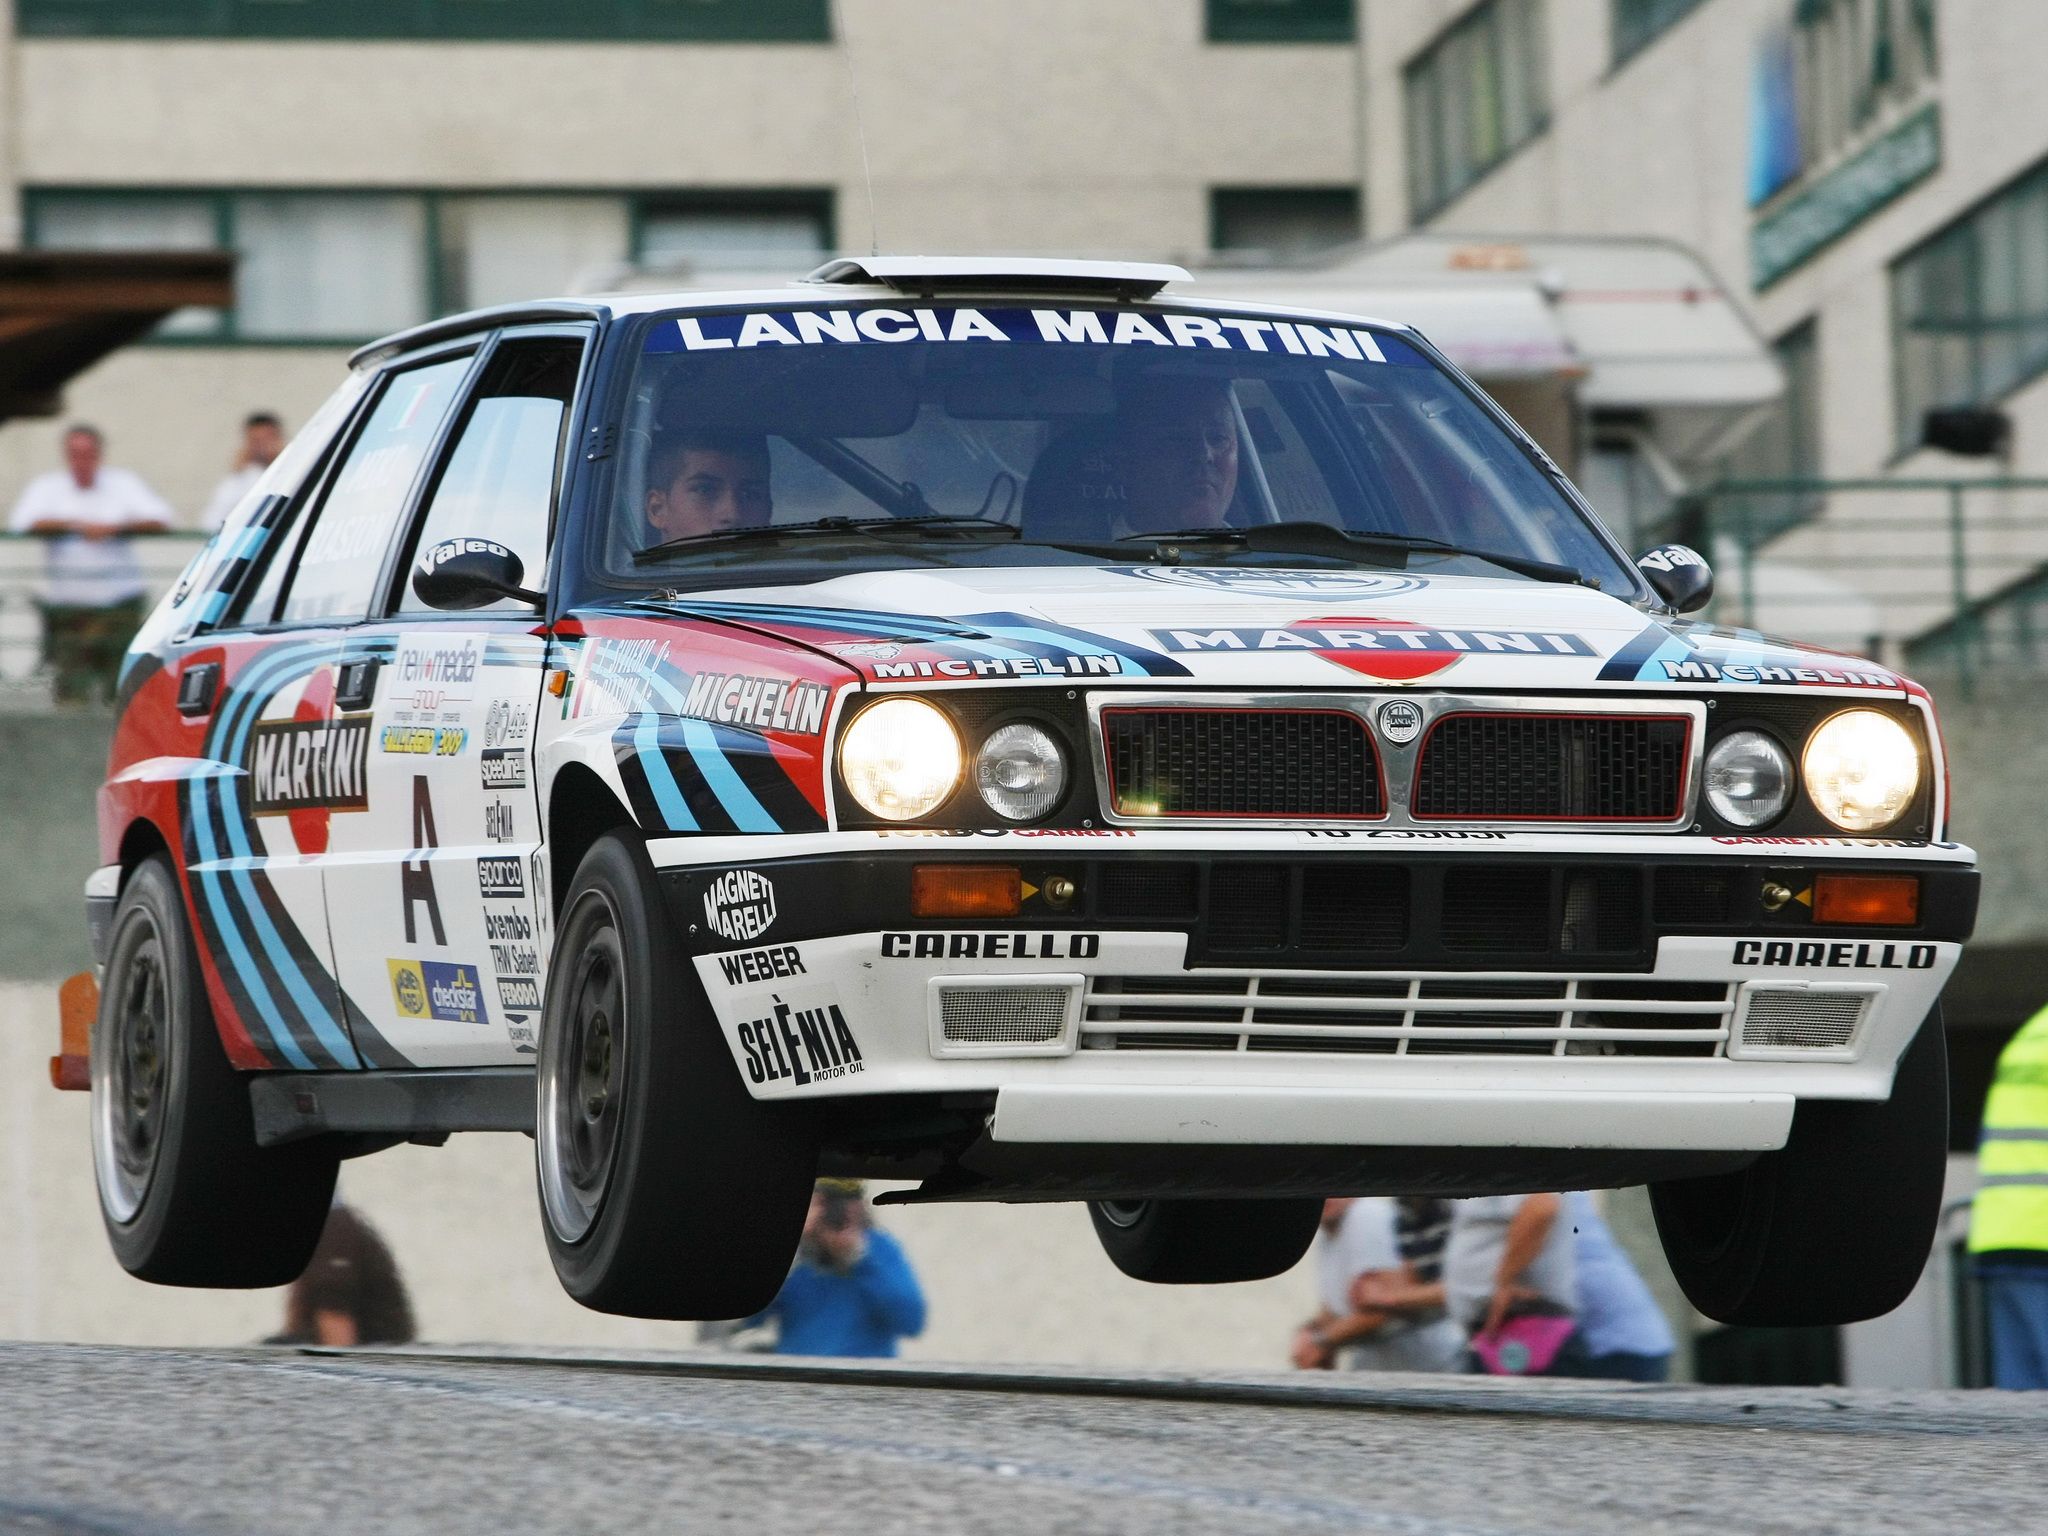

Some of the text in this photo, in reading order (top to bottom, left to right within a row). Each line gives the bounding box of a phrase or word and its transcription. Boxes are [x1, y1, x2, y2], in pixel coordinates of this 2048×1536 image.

[676, 308, 1388, 364] LANCIA MARTINI
[418, 538, 509, 577] Valeo
[1168, 629, 1579, 656] MARTINI
[872, 653, 1125, 680] MICHELIN
[1660, 660, 1899, 688] MICHELIN
[681, 672, 832, 736] MICHELIN
[1389, 717, 1412, 726] LANCIA
[253, 726, 368, 802] MARTINI
[402, 774, 448, 947] A
[478, 860, 523, 895] sparco
[703, 869, 775, 910] MAGNETI
[482, 905, 531, 940] brembo
[706, 902, 778, 941] MARELLI
[489, 944, 541, 975] TRW Sabelt
[882, 932, 1101, 959] CARELLO
[1732, 940, 1938, 970] CARELLO
[718, 945, 807, 986] WEBER
[499, 981, 537, 1006] FERODO
[737, 993, 863, 1087] SELÈNIA
[813, 1061, 865, 1083] MOTOR OIL
